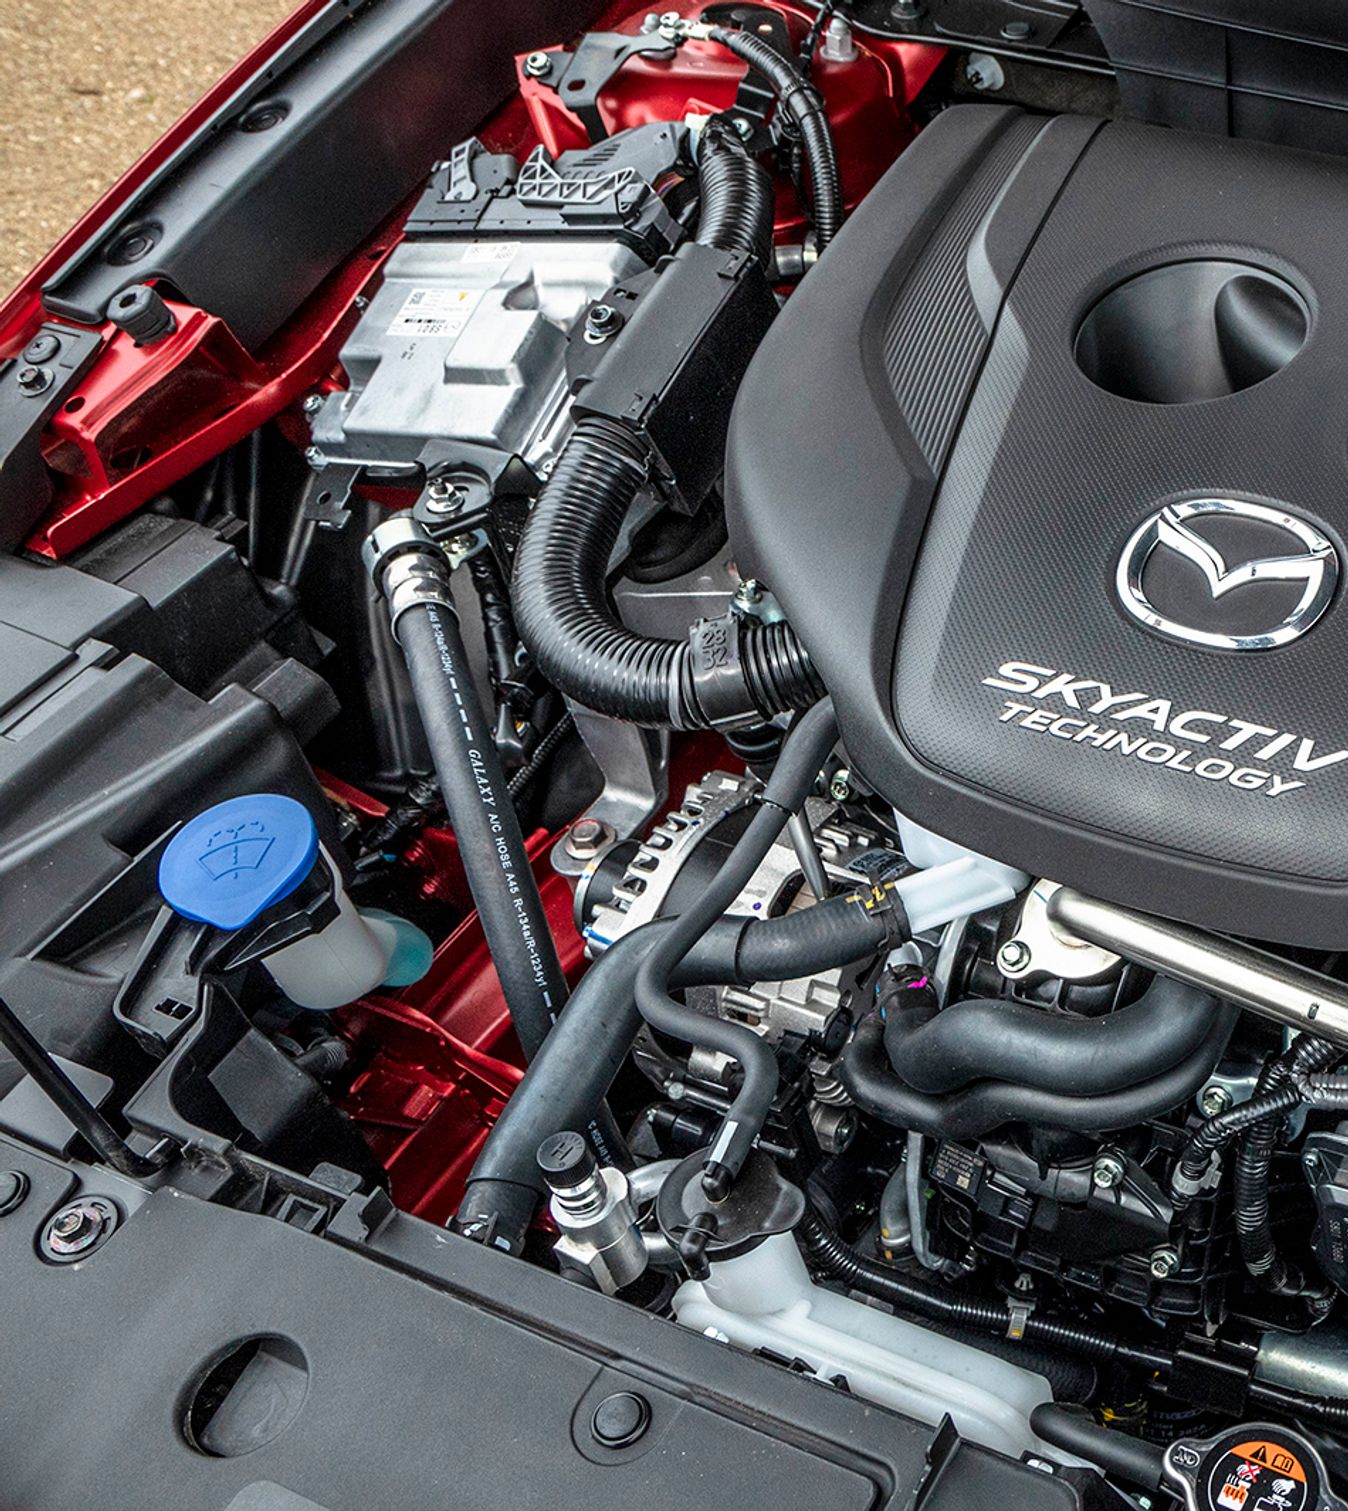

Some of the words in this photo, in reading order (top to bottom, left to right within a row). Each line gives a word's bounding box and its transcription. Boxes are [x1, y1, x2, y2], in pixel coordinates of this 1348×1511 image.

[999, 701, 1306, 796] TECHNOLOGY
[468, 749, 496, 807] GALAXY
[488, 813, 502, 833] A/C
[495, 837, 512, 869] HOSE
[505, 873, 519, 894] A45
[513, 898, 548, 987] R-134a/R-1234yf
